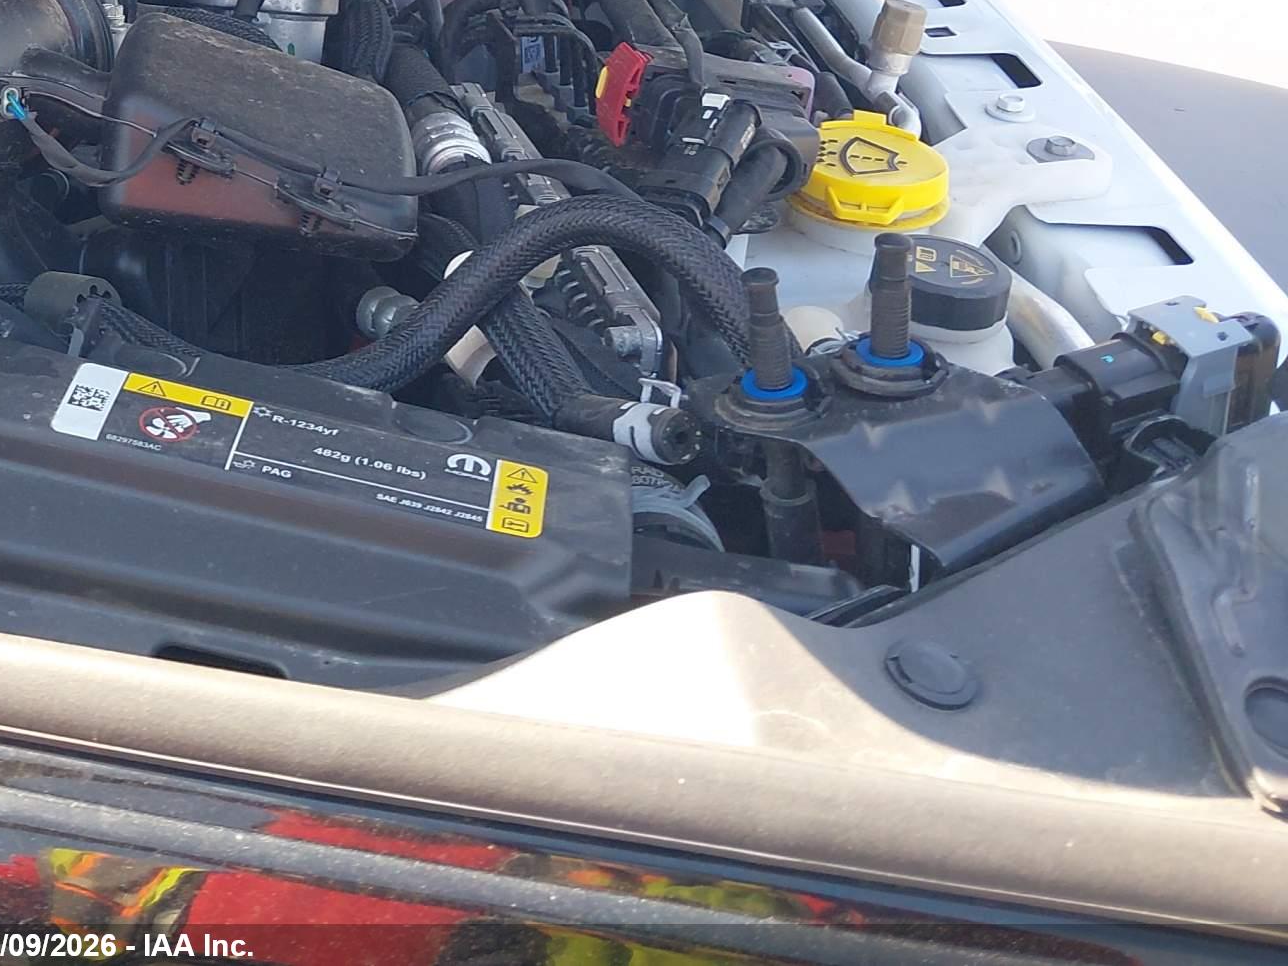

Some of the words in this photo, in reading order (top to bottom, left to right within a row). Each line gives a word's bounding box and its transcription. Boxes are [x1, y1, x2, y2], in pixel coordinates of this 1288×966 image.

[272, 415, 339, 436] R-1234yf
[261, 465, 292, 478] PAG
[313, 447, 351, 463] 482g
[354, 456, 393, 471] (1.06
[396, 465, 427, 480] lbs)
[376, 493, 398, 504] SAE
